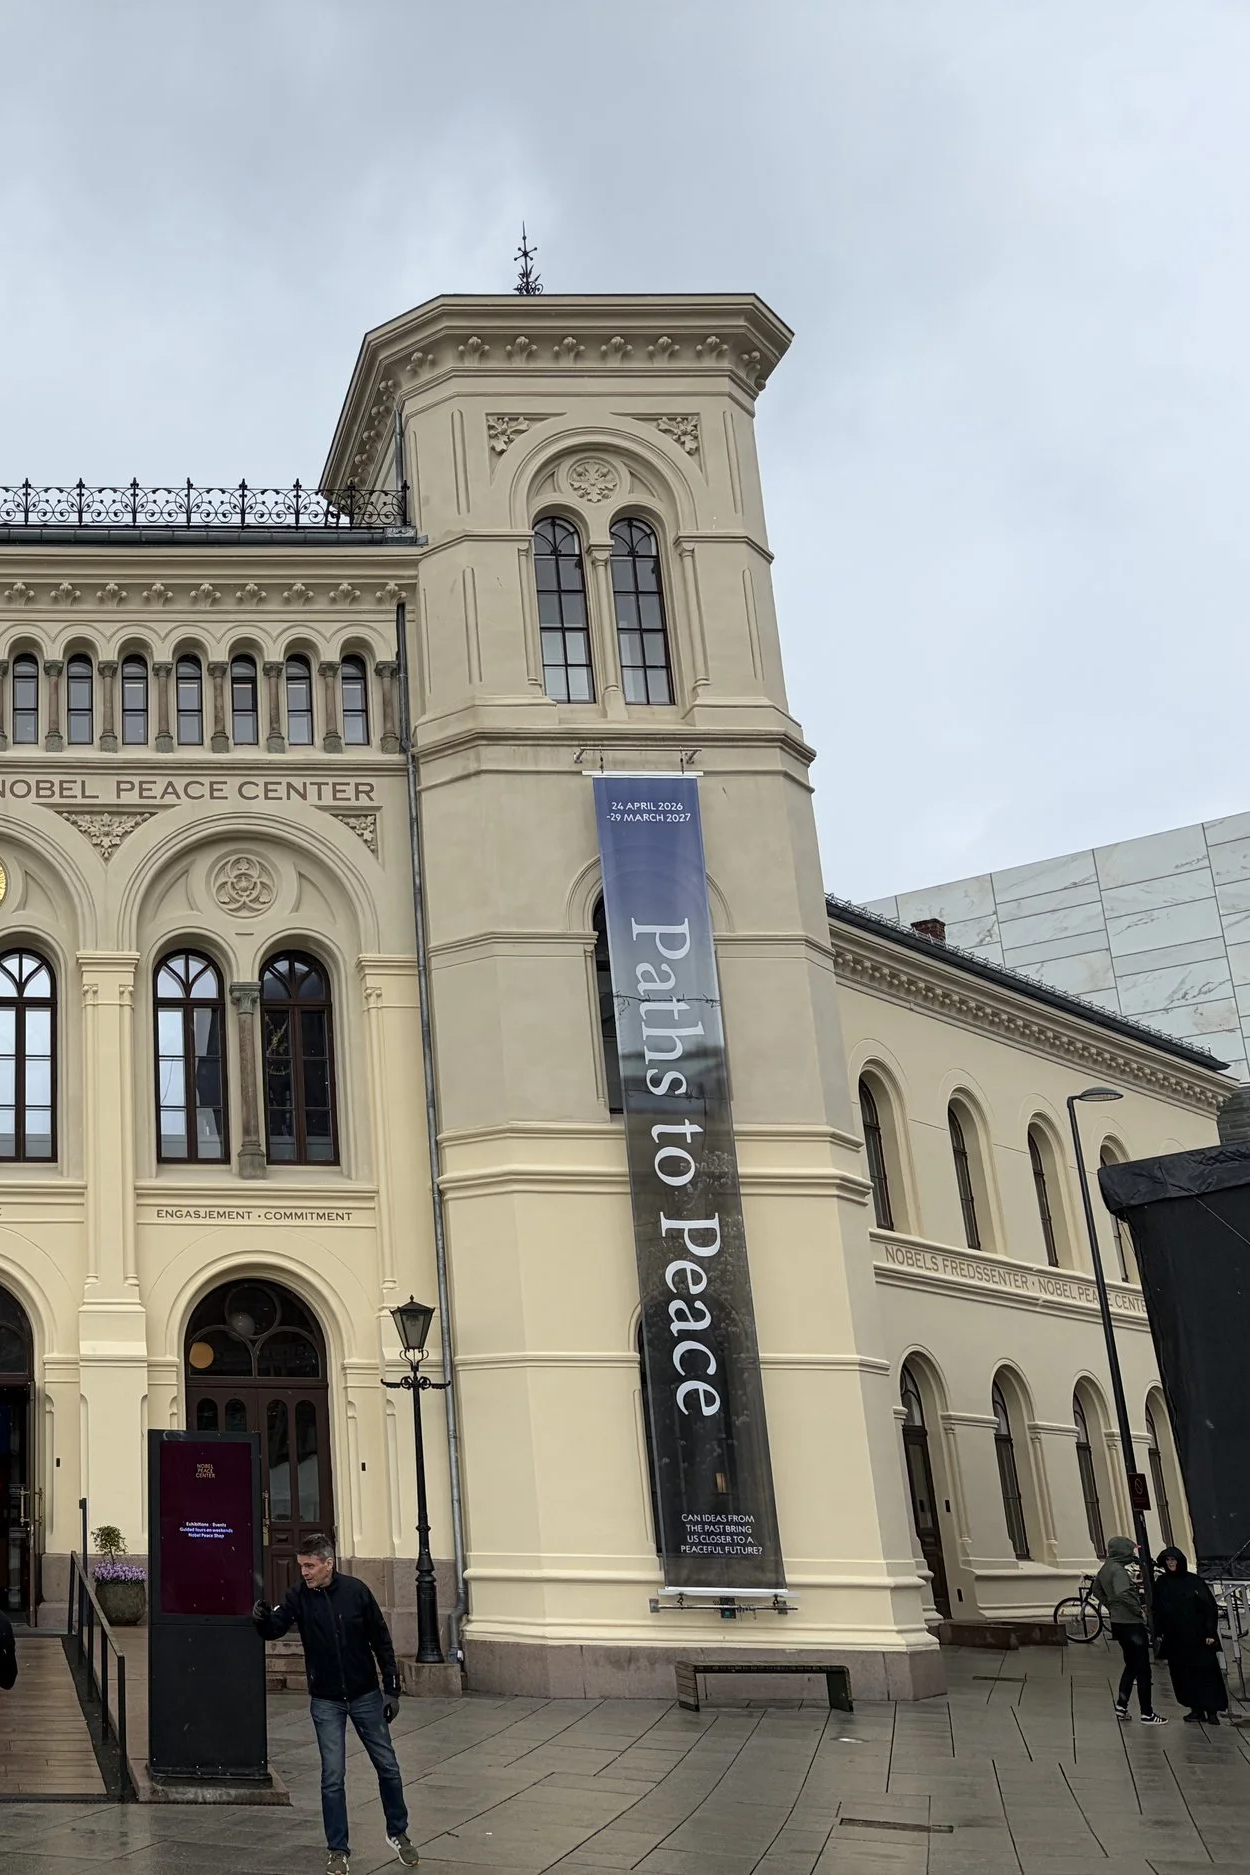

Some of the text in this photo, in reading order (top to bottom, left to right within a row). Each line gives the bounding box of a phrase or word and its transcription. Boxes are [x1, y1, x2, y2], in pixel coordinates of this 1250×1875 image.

[115, 780, 229, 800] PEACE
[238, 780, 376, 801] CENTER
[611, 801, 684, 811] 24 APRIL 2026
[606, 812, 691, 822] -29 MARCH 2027
[631, 917, 722, 1417] Paths to Peace
[156, 1209, 353, 1221] ENGASJEMENT COMMITMENT
[885, 1246, 939, 1272] NOBELS
[942, 1257, 1030, 1290] FREDSSENTER
[1037, 1278, 1077, 1300] NOBEL
[1115, 1293, 1148, 1313] CENTE
[681, 1513, 755, 1523] CAN IDEAS FROM
[686, 1524, 752, 1534] THE PAST BRING
[687, 1535, 754, 1544] US CLOSER TO A
[680, 1545, 763, 1555] PEACEFUL FUTURE?
